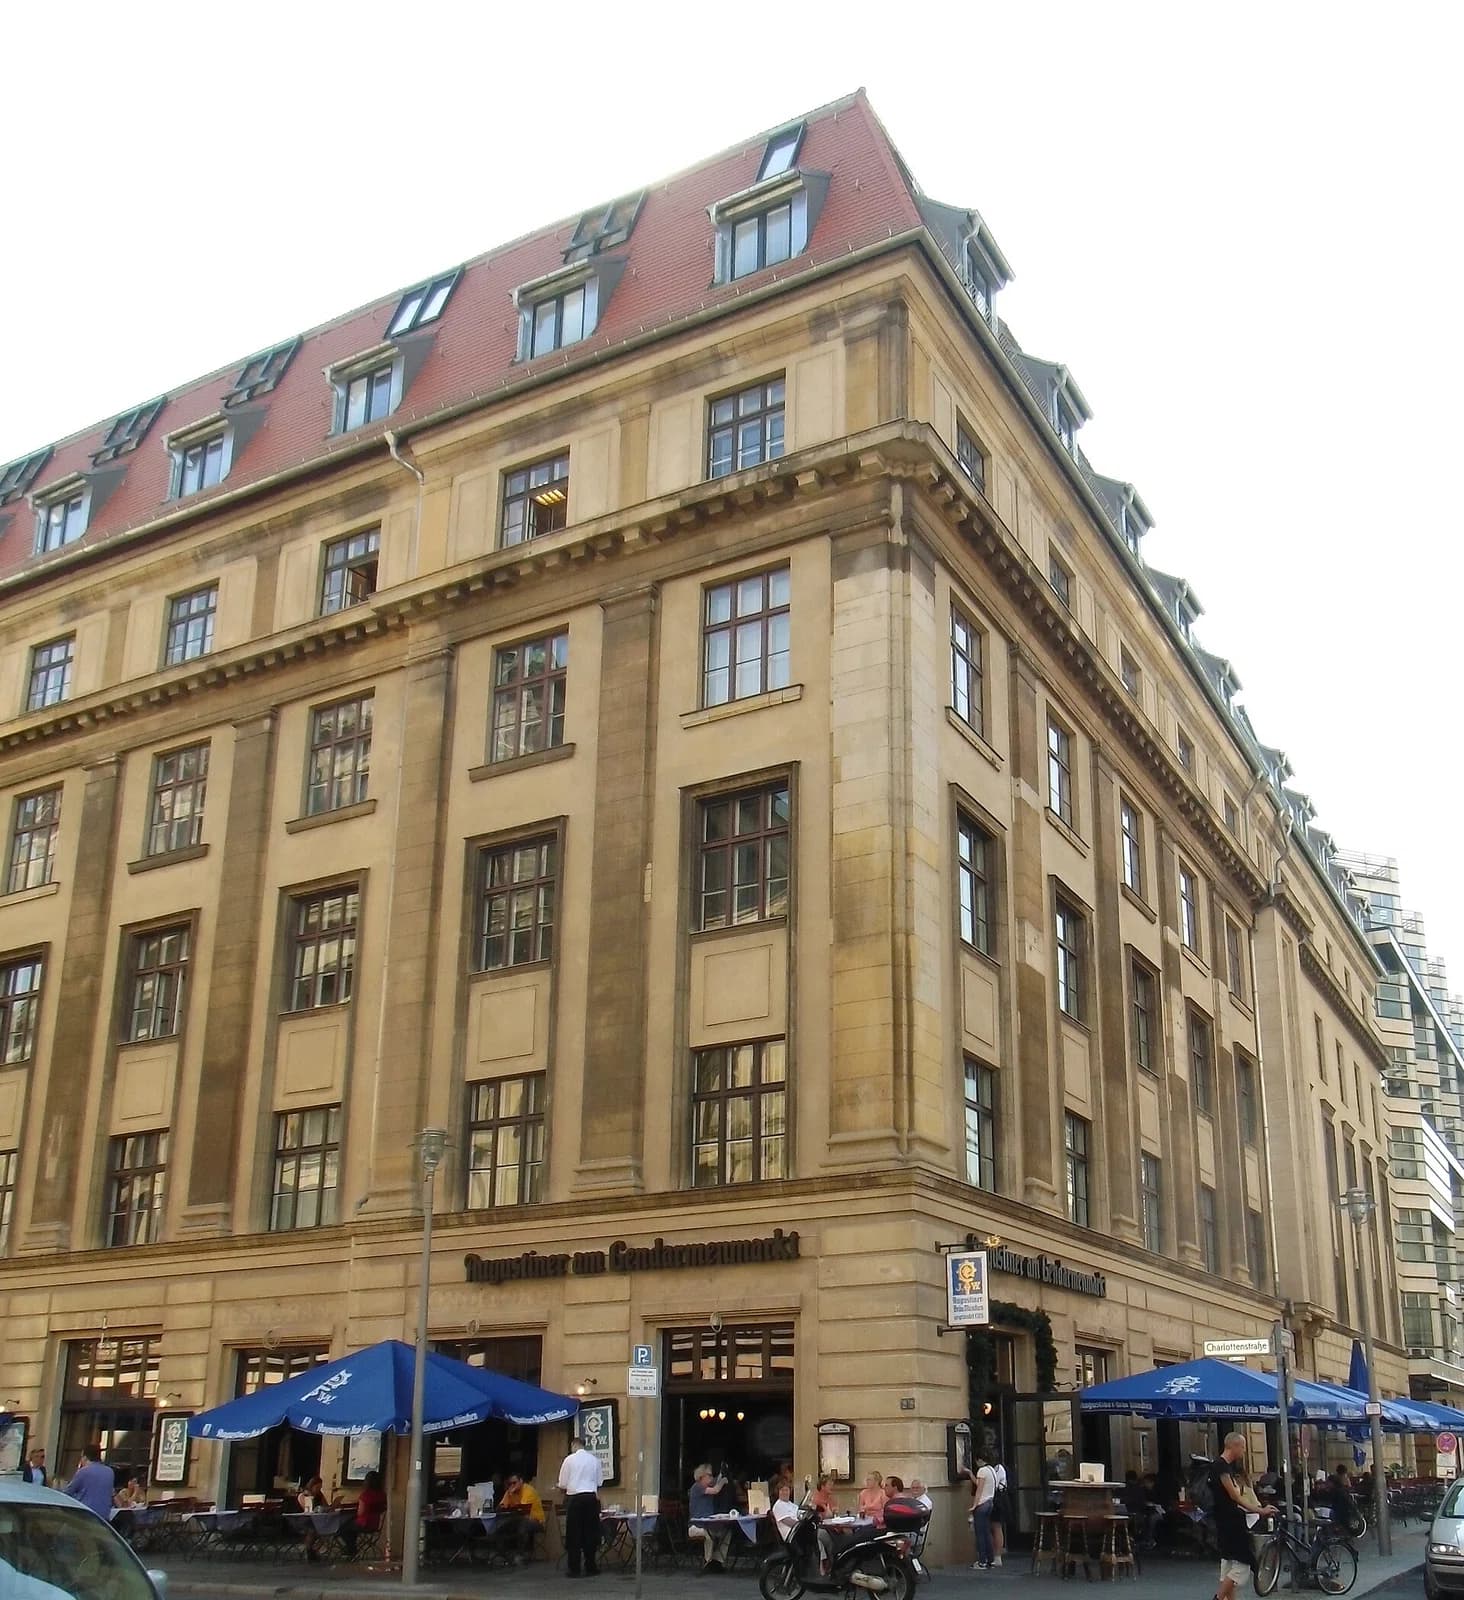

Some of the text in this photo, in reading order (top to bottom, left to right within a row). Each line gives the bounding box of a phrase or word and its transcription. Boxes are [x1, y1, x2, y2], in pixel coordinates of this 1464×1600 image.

[464, 1228, 800, 1285] Augustiner am Gendarmenmarkt
[638, 1347, 649, 1364] P
[1206, 1342, 1268, 1352] Charlottenstraße
